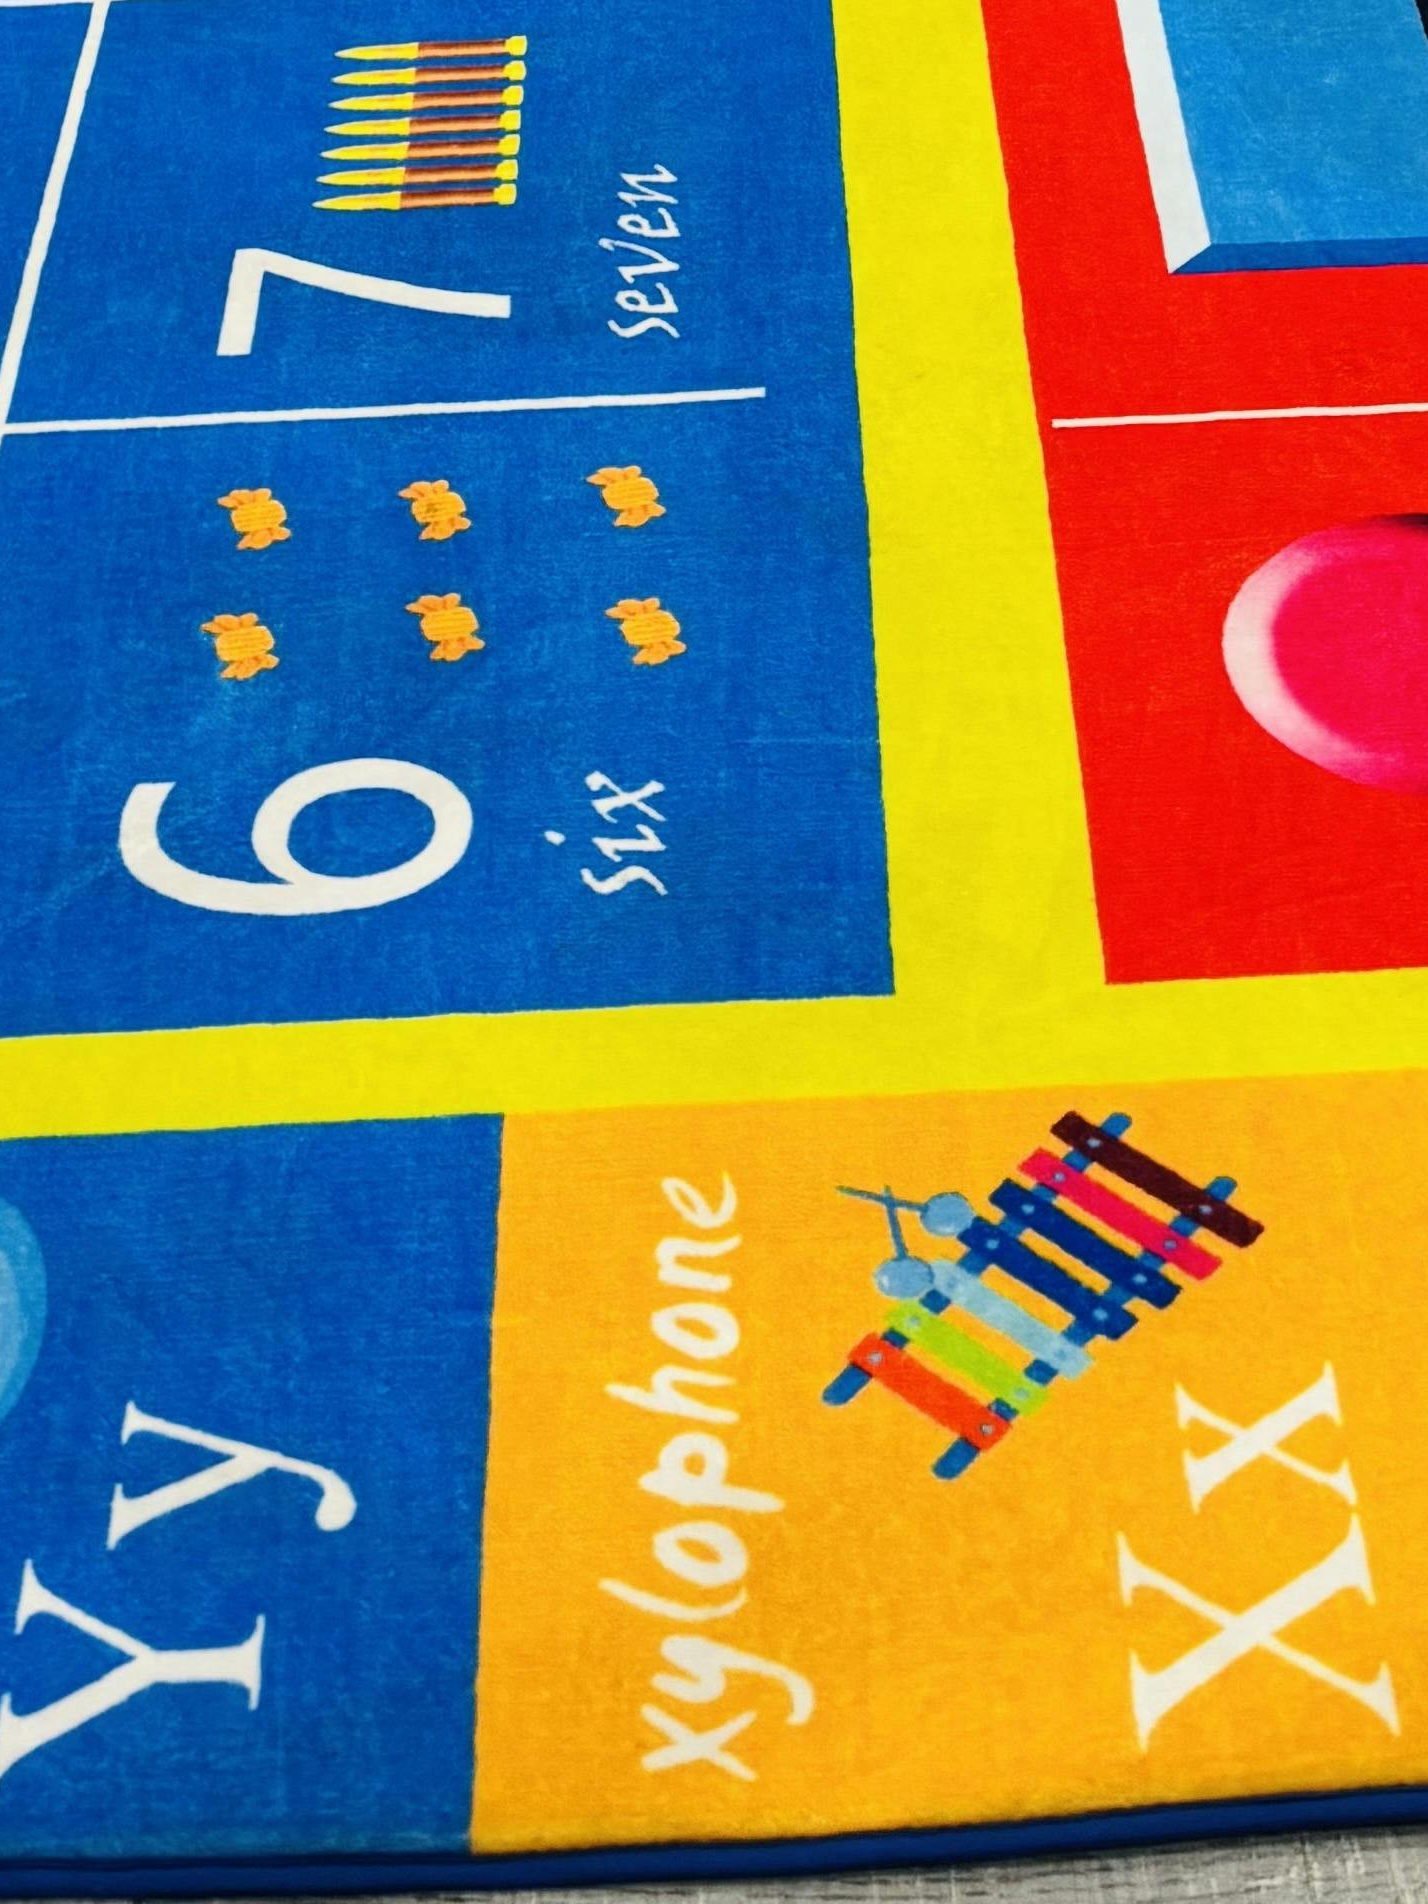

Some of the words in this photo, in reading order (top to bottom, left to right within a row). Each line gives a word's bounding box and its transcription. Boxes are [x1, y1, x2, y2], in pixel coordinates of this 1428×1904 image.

[216, 247, 512, 357] 7
[598, 163, 681, 339] seven
[117, 757, 474, 917] 6
[544, 770, 668, 896] six
[599, 1177, 815, 1781] xylophone
[1117, 1364, 1399, 1749] Xx
